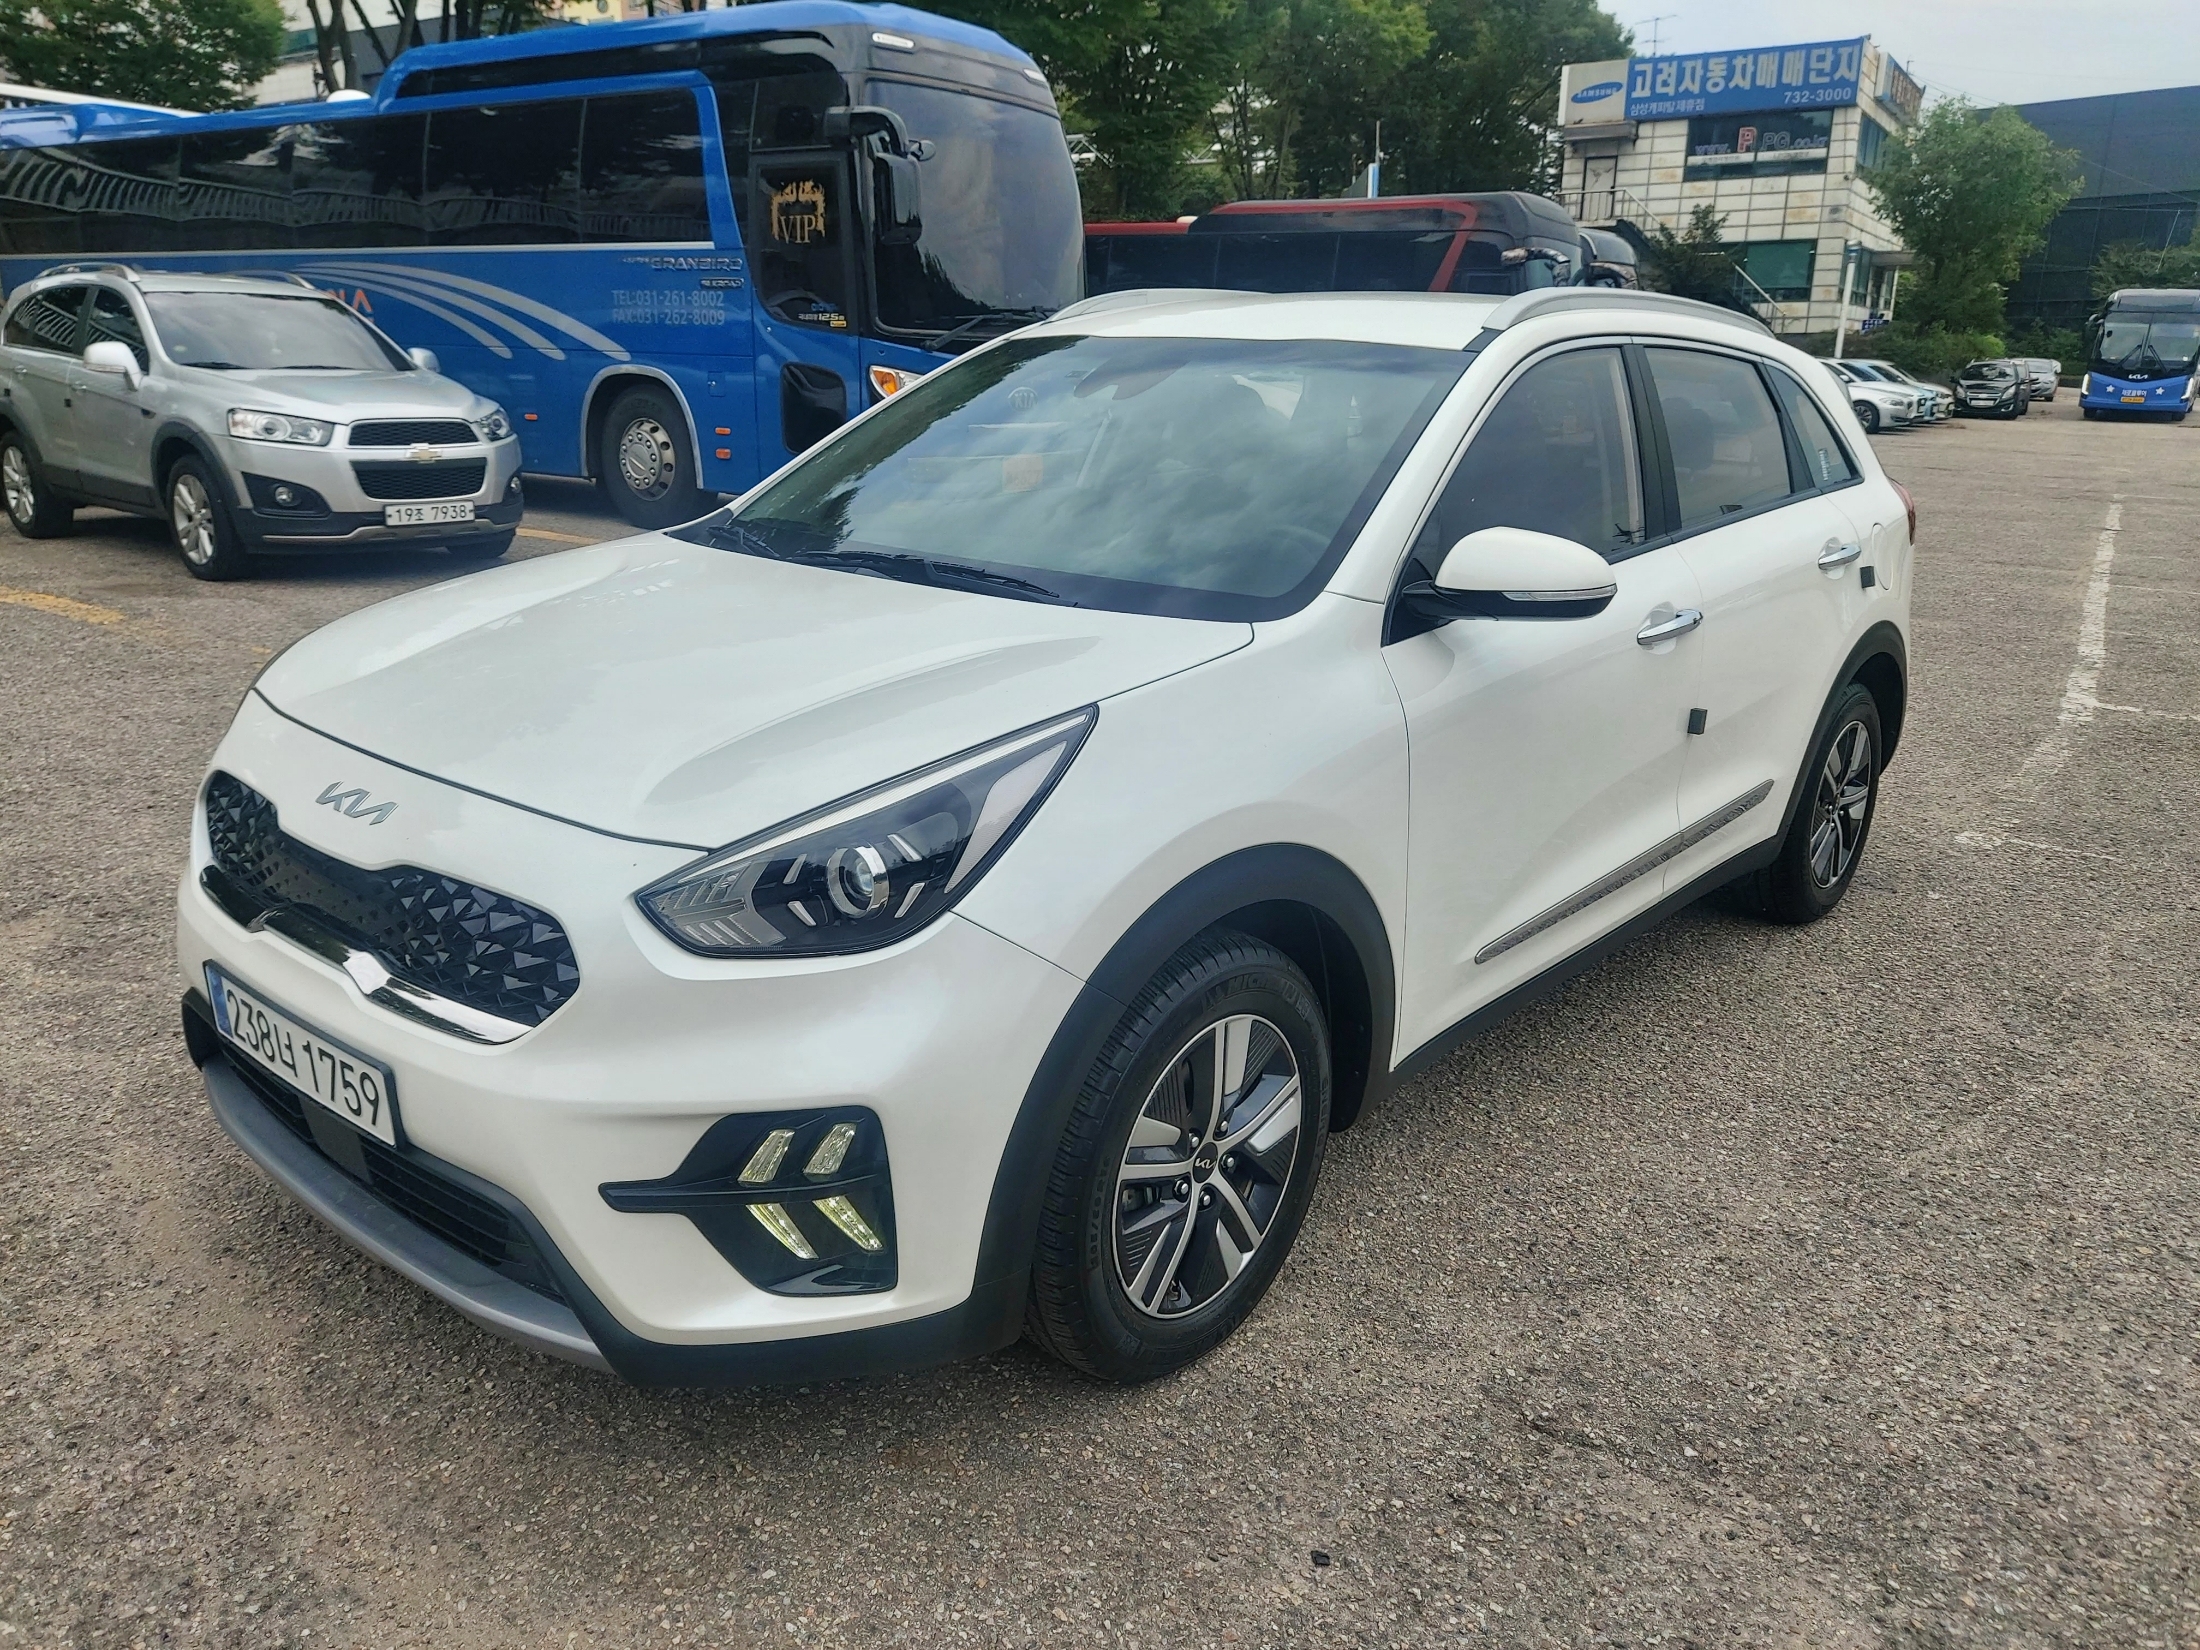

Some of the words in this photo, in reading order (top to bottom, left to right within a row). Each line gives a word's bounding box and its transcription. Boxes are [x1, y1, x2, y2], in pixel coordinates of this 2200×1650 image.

[1631, 45, 1860, 98] 고려자동차매매단지
[1577, 87, 1617, 98] SAMSUNG
[1784, 88, 1851, 104] 732-3000
[780, 214, 816, 243] VIP
[395, 508, 424, 522] 19조
[431, 504, 467, 521] 7938
[315, 780, 399, 826] KIA
[226, 989, 298, 1078] 238너
[302, 1040, 379, 1126] 1759
